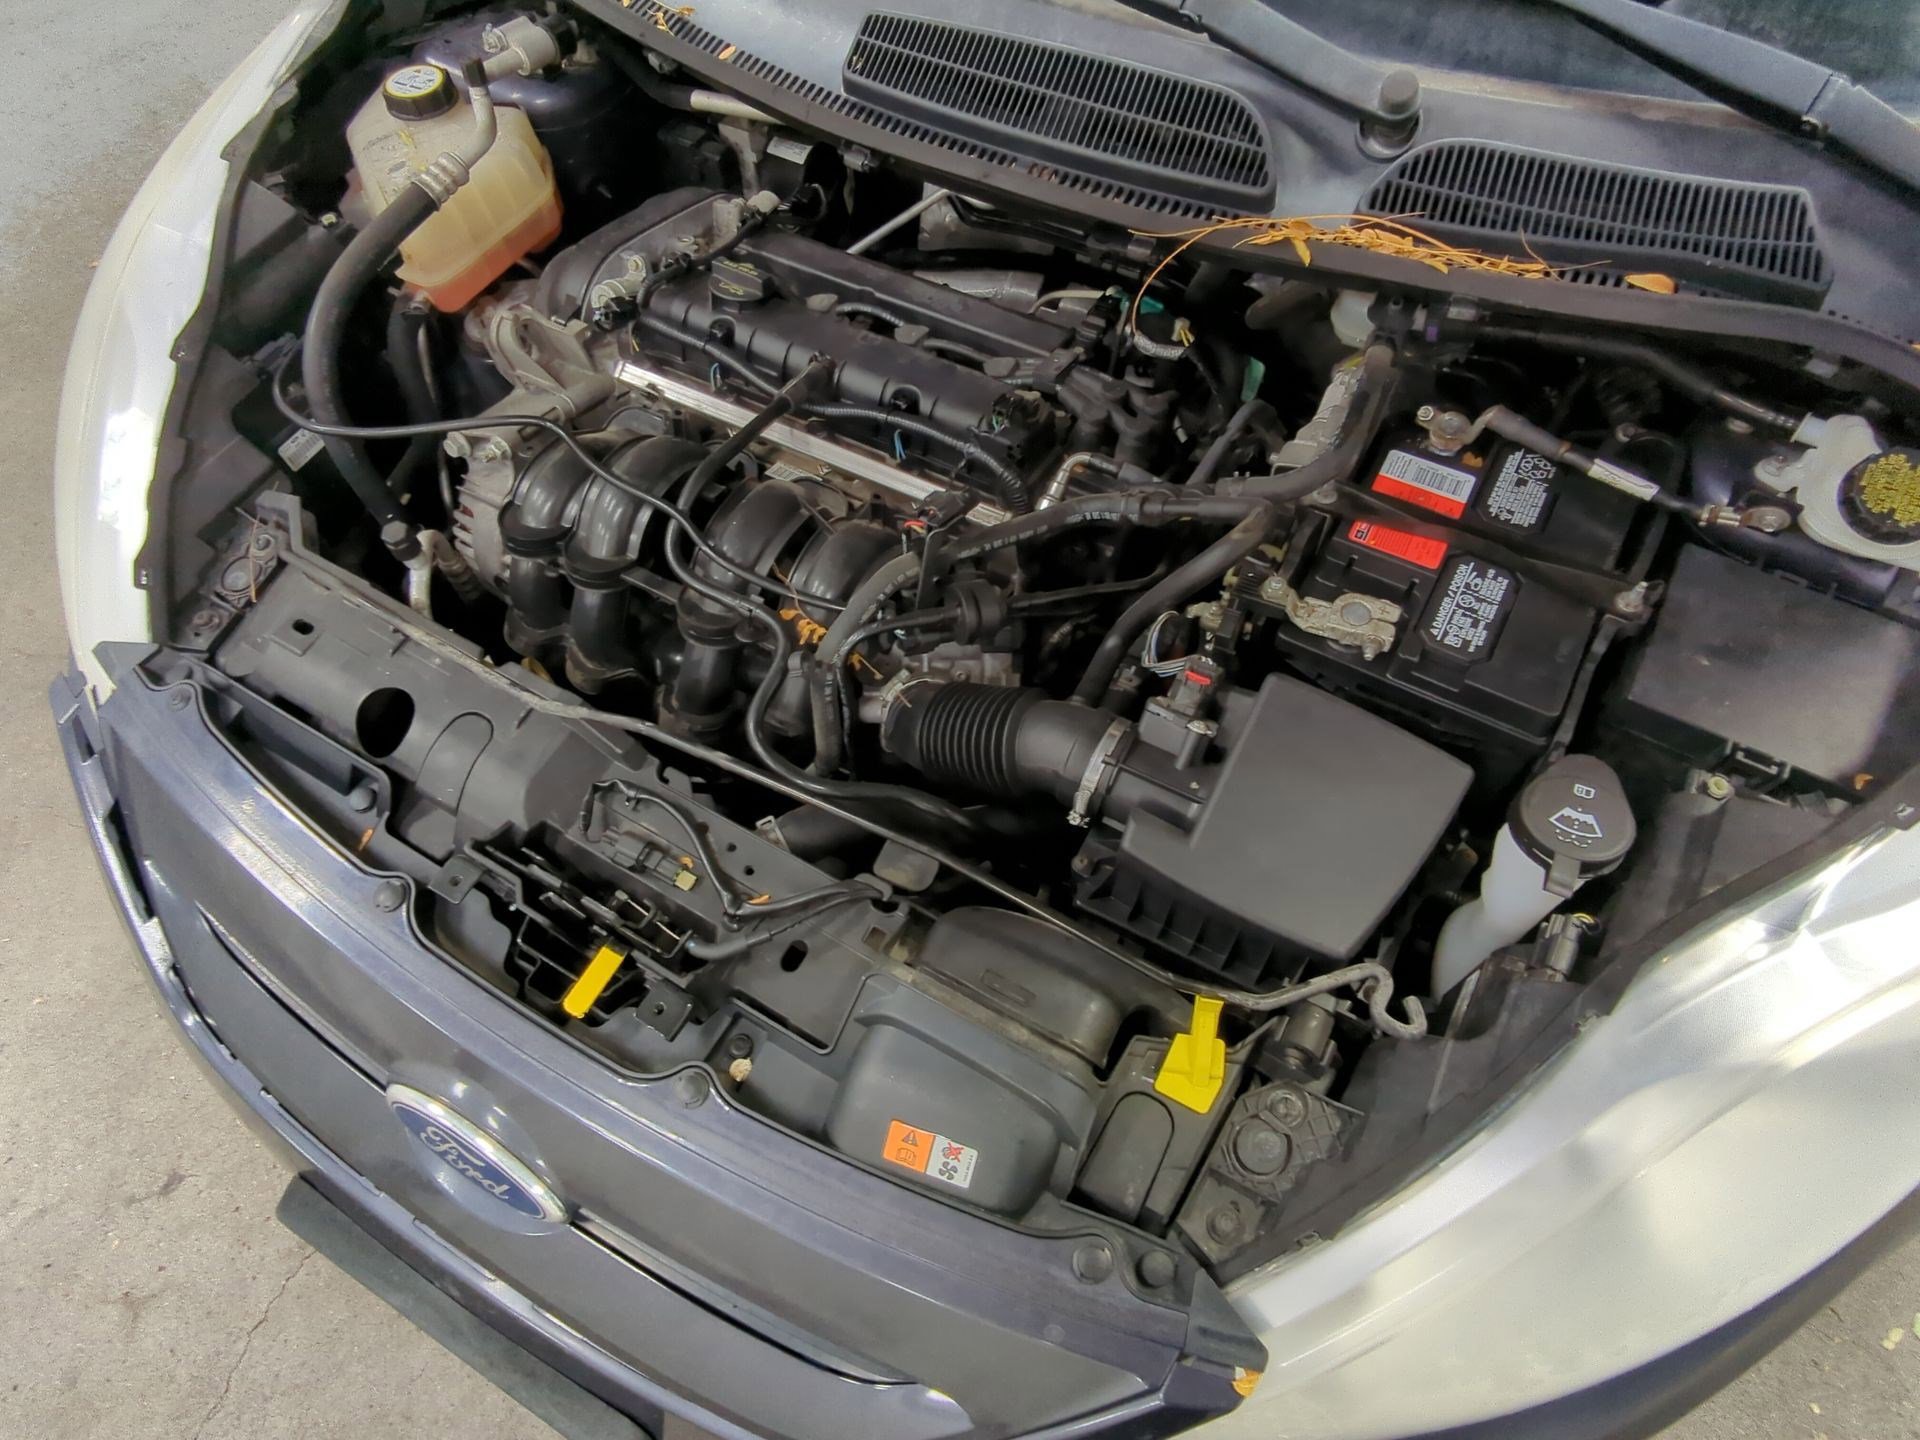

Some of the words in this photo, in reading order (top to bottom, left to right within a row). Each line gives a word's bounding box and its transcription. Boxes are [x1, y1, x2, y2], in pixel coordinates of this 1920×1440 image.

[1434, 596, 1453, 628] DANGER
[1450, 563, 1468, 591] POISON
[419, 1127, 510, 1198] Ford
